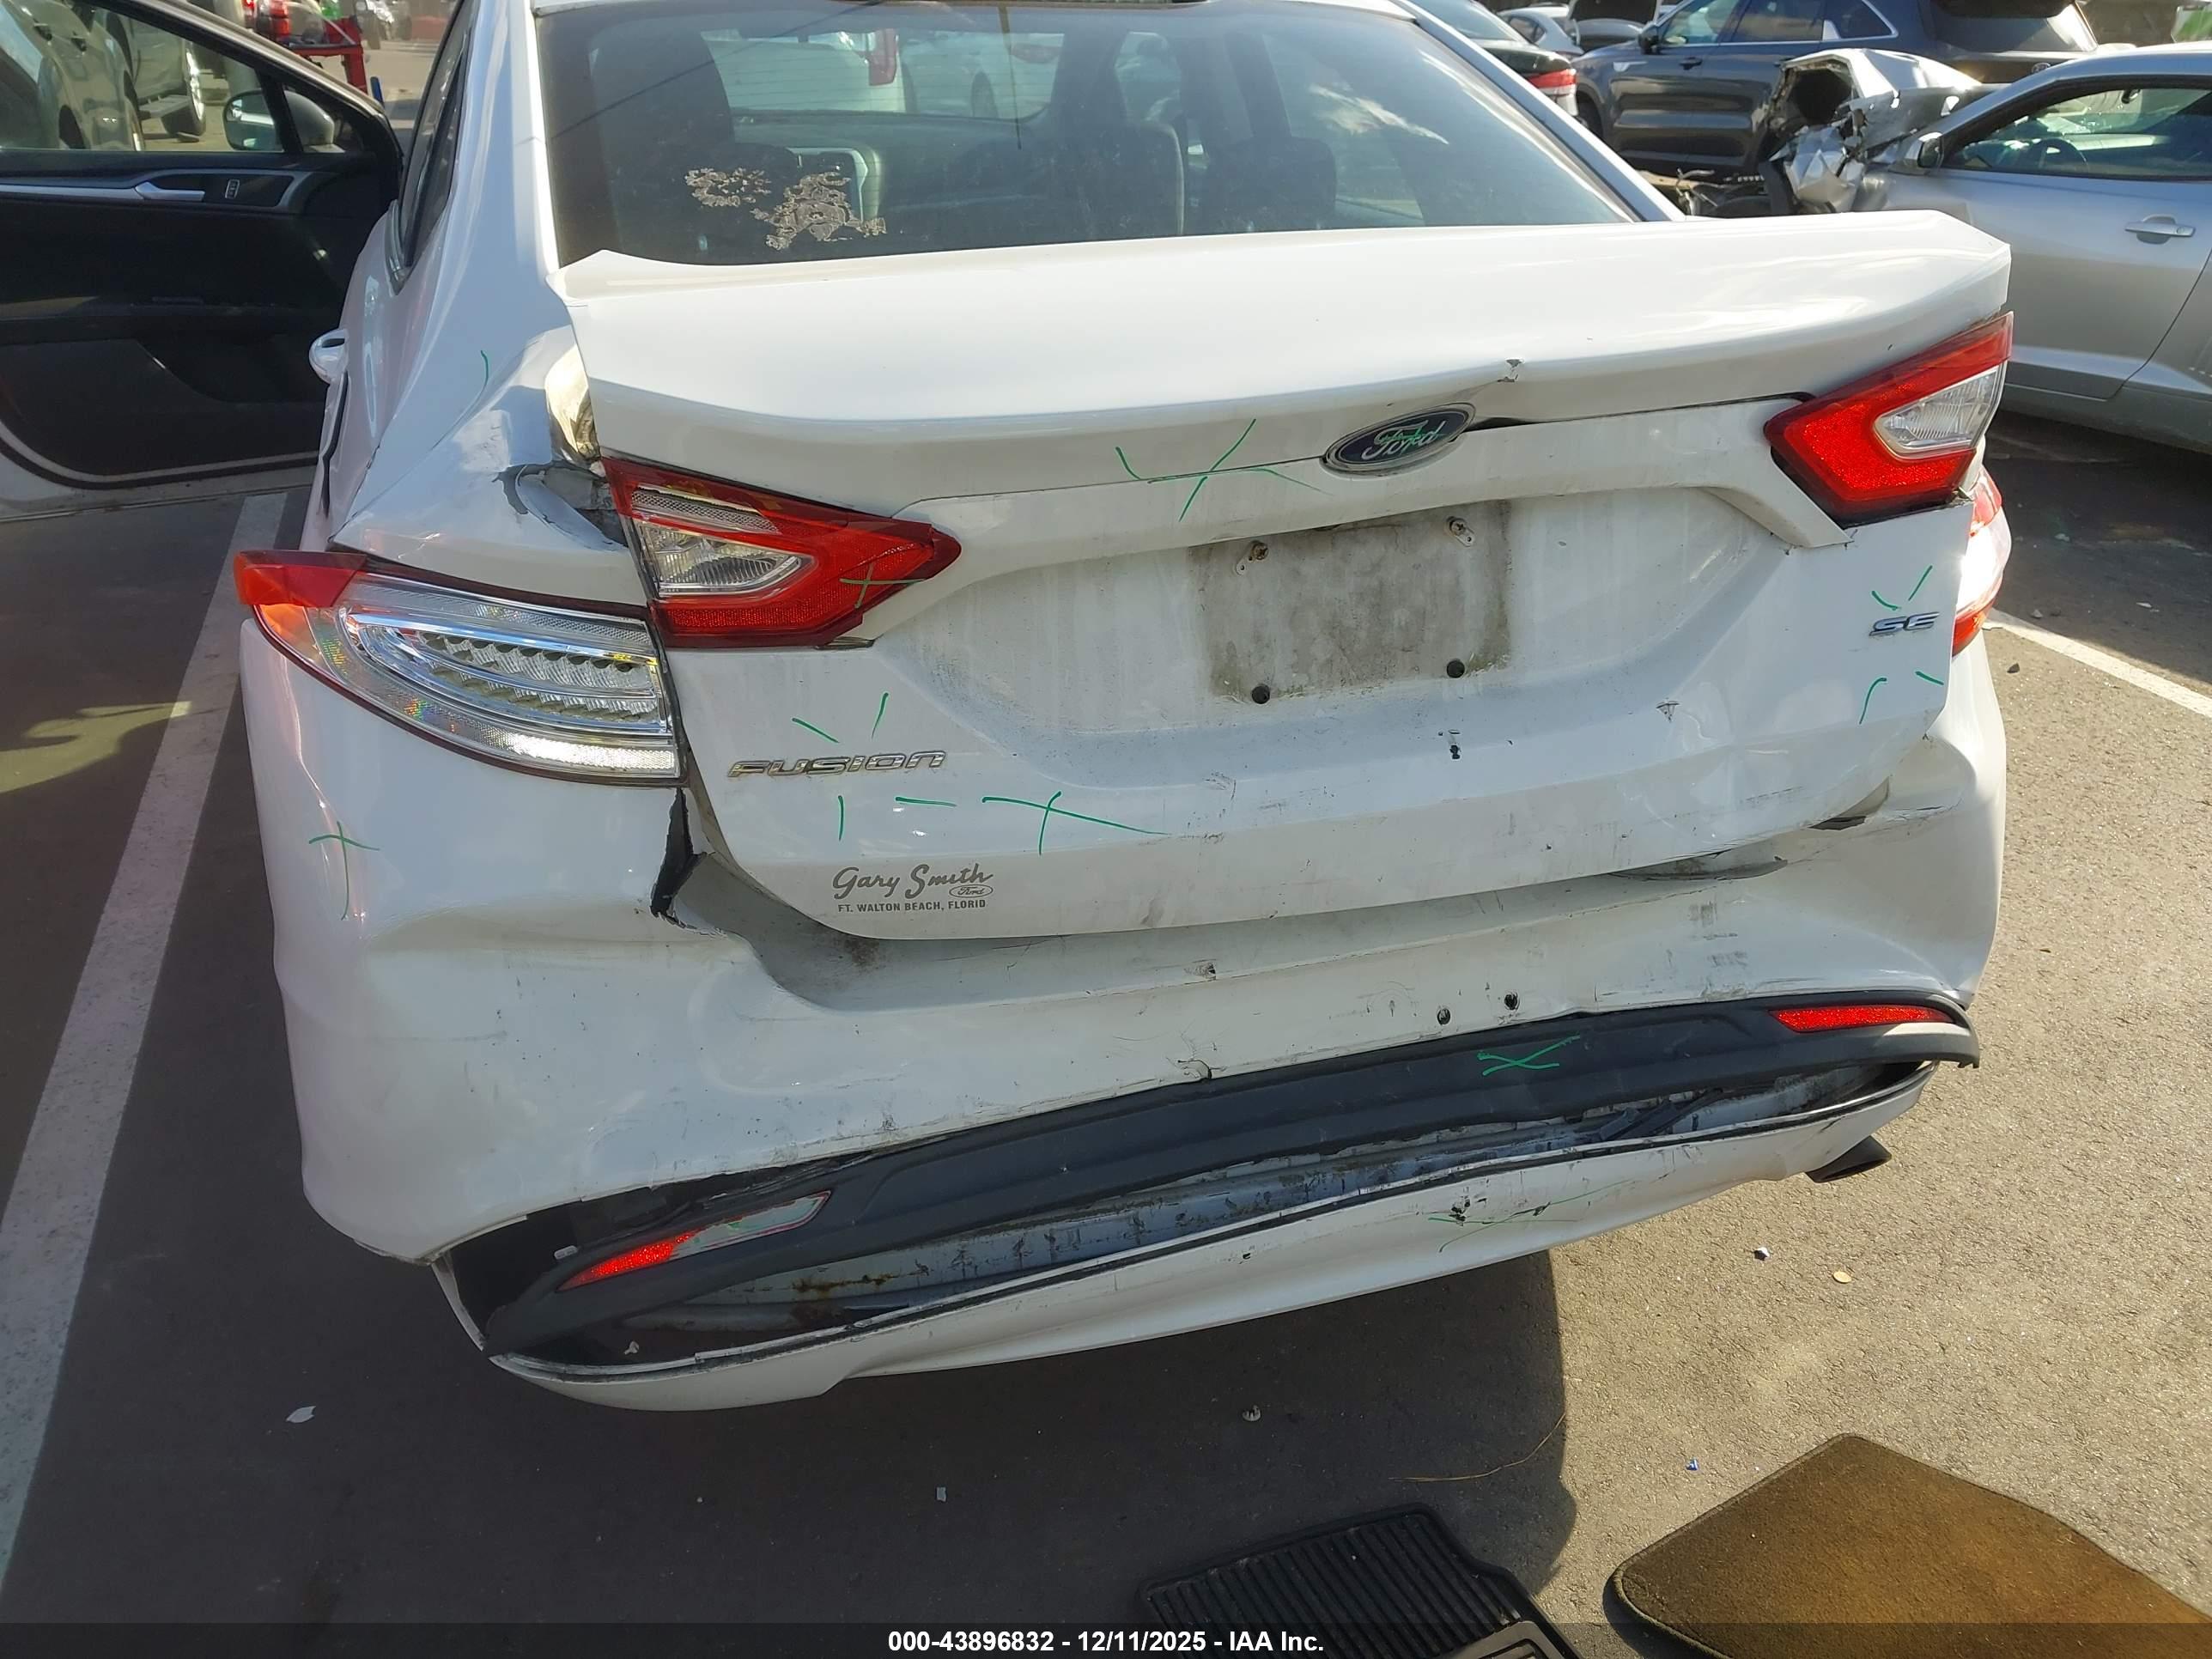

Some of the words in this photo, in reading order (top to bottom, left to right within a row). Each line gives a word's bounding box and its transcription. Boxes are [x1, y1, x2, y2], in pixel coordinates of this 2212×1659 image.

[1361, 419, 1447, 459] Ford
[1869, 611, 1940, 636] SE
[832, 866, 901, 900] Gary
[904, 863, 994, 900] Smith
[957, 886, 986, 895] Ford
[838, 904, 854, 913] FT.
[857, 902, 901, 913] WALTON
[904, 902, 945, 911] BEACH,
[948, 899, 987, 909] FLORID
